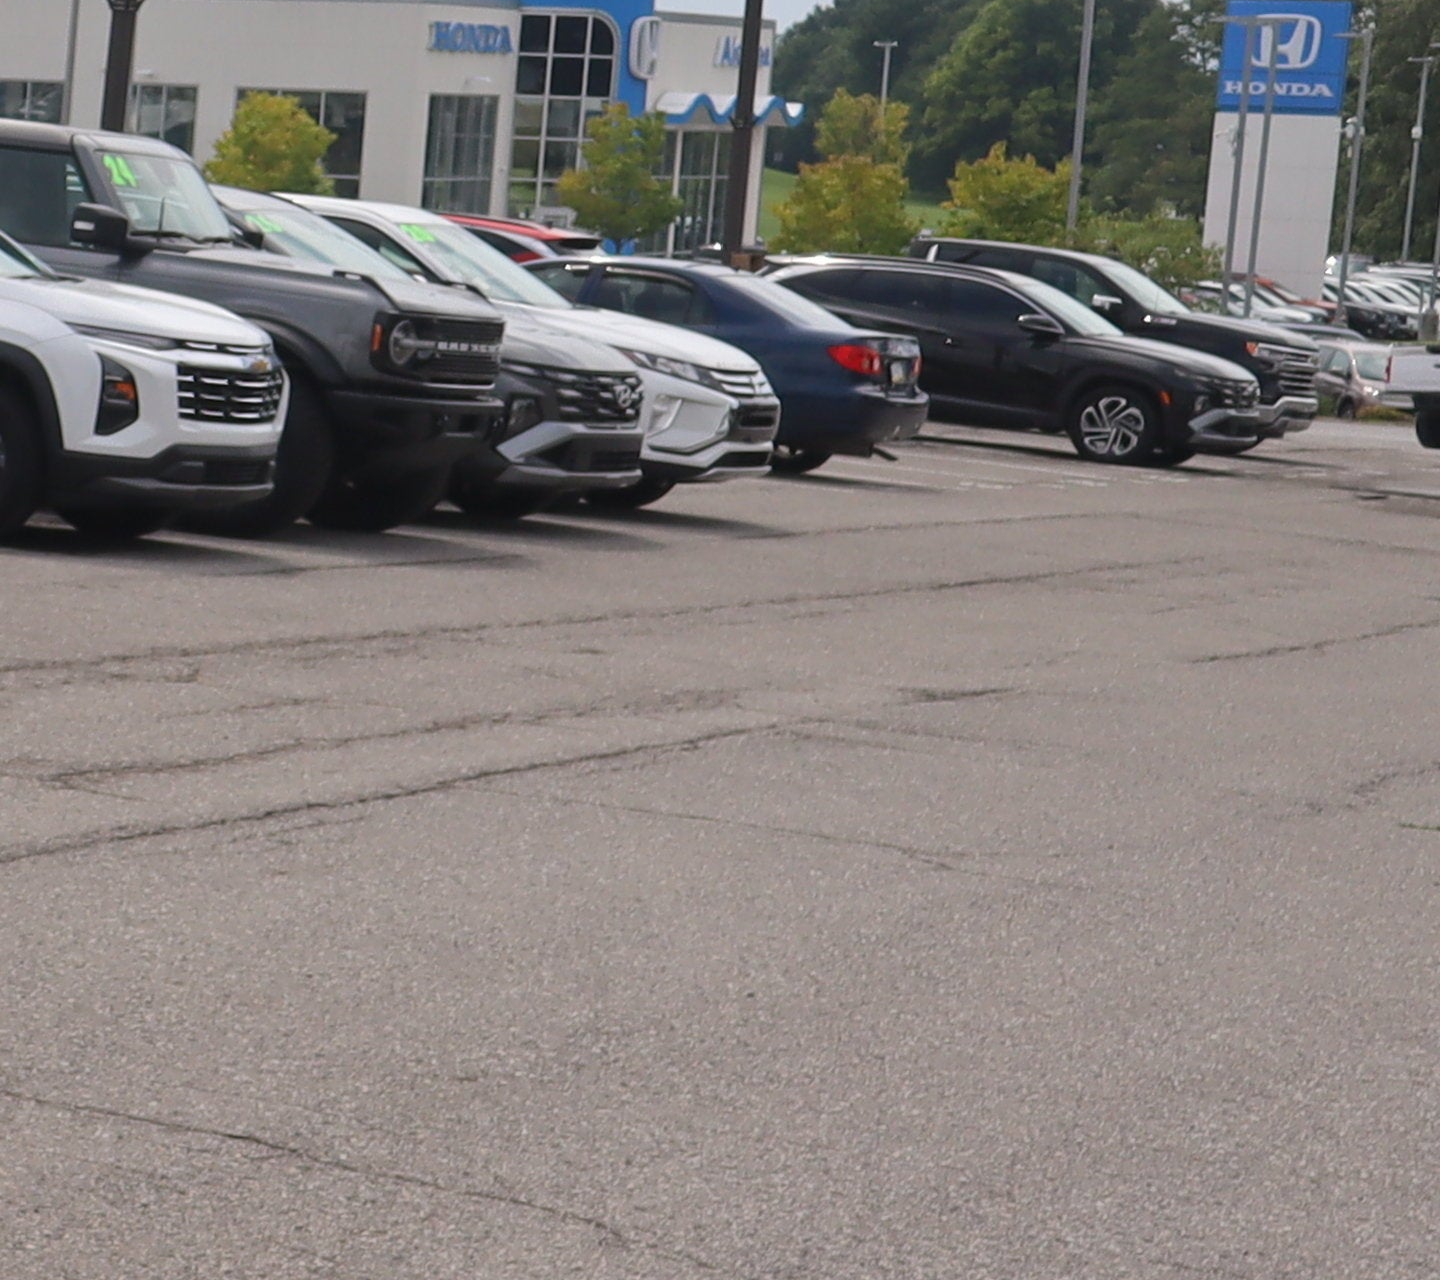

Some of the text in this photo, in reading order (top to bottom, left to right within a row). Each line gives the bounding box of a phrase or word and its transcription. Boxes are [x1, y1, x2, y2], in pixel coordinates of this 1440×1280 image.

[431, 21, 513, 54] HONDA
[1222, 79, 1334, 98] HONDA
[102, 153, 138, 188] 24
